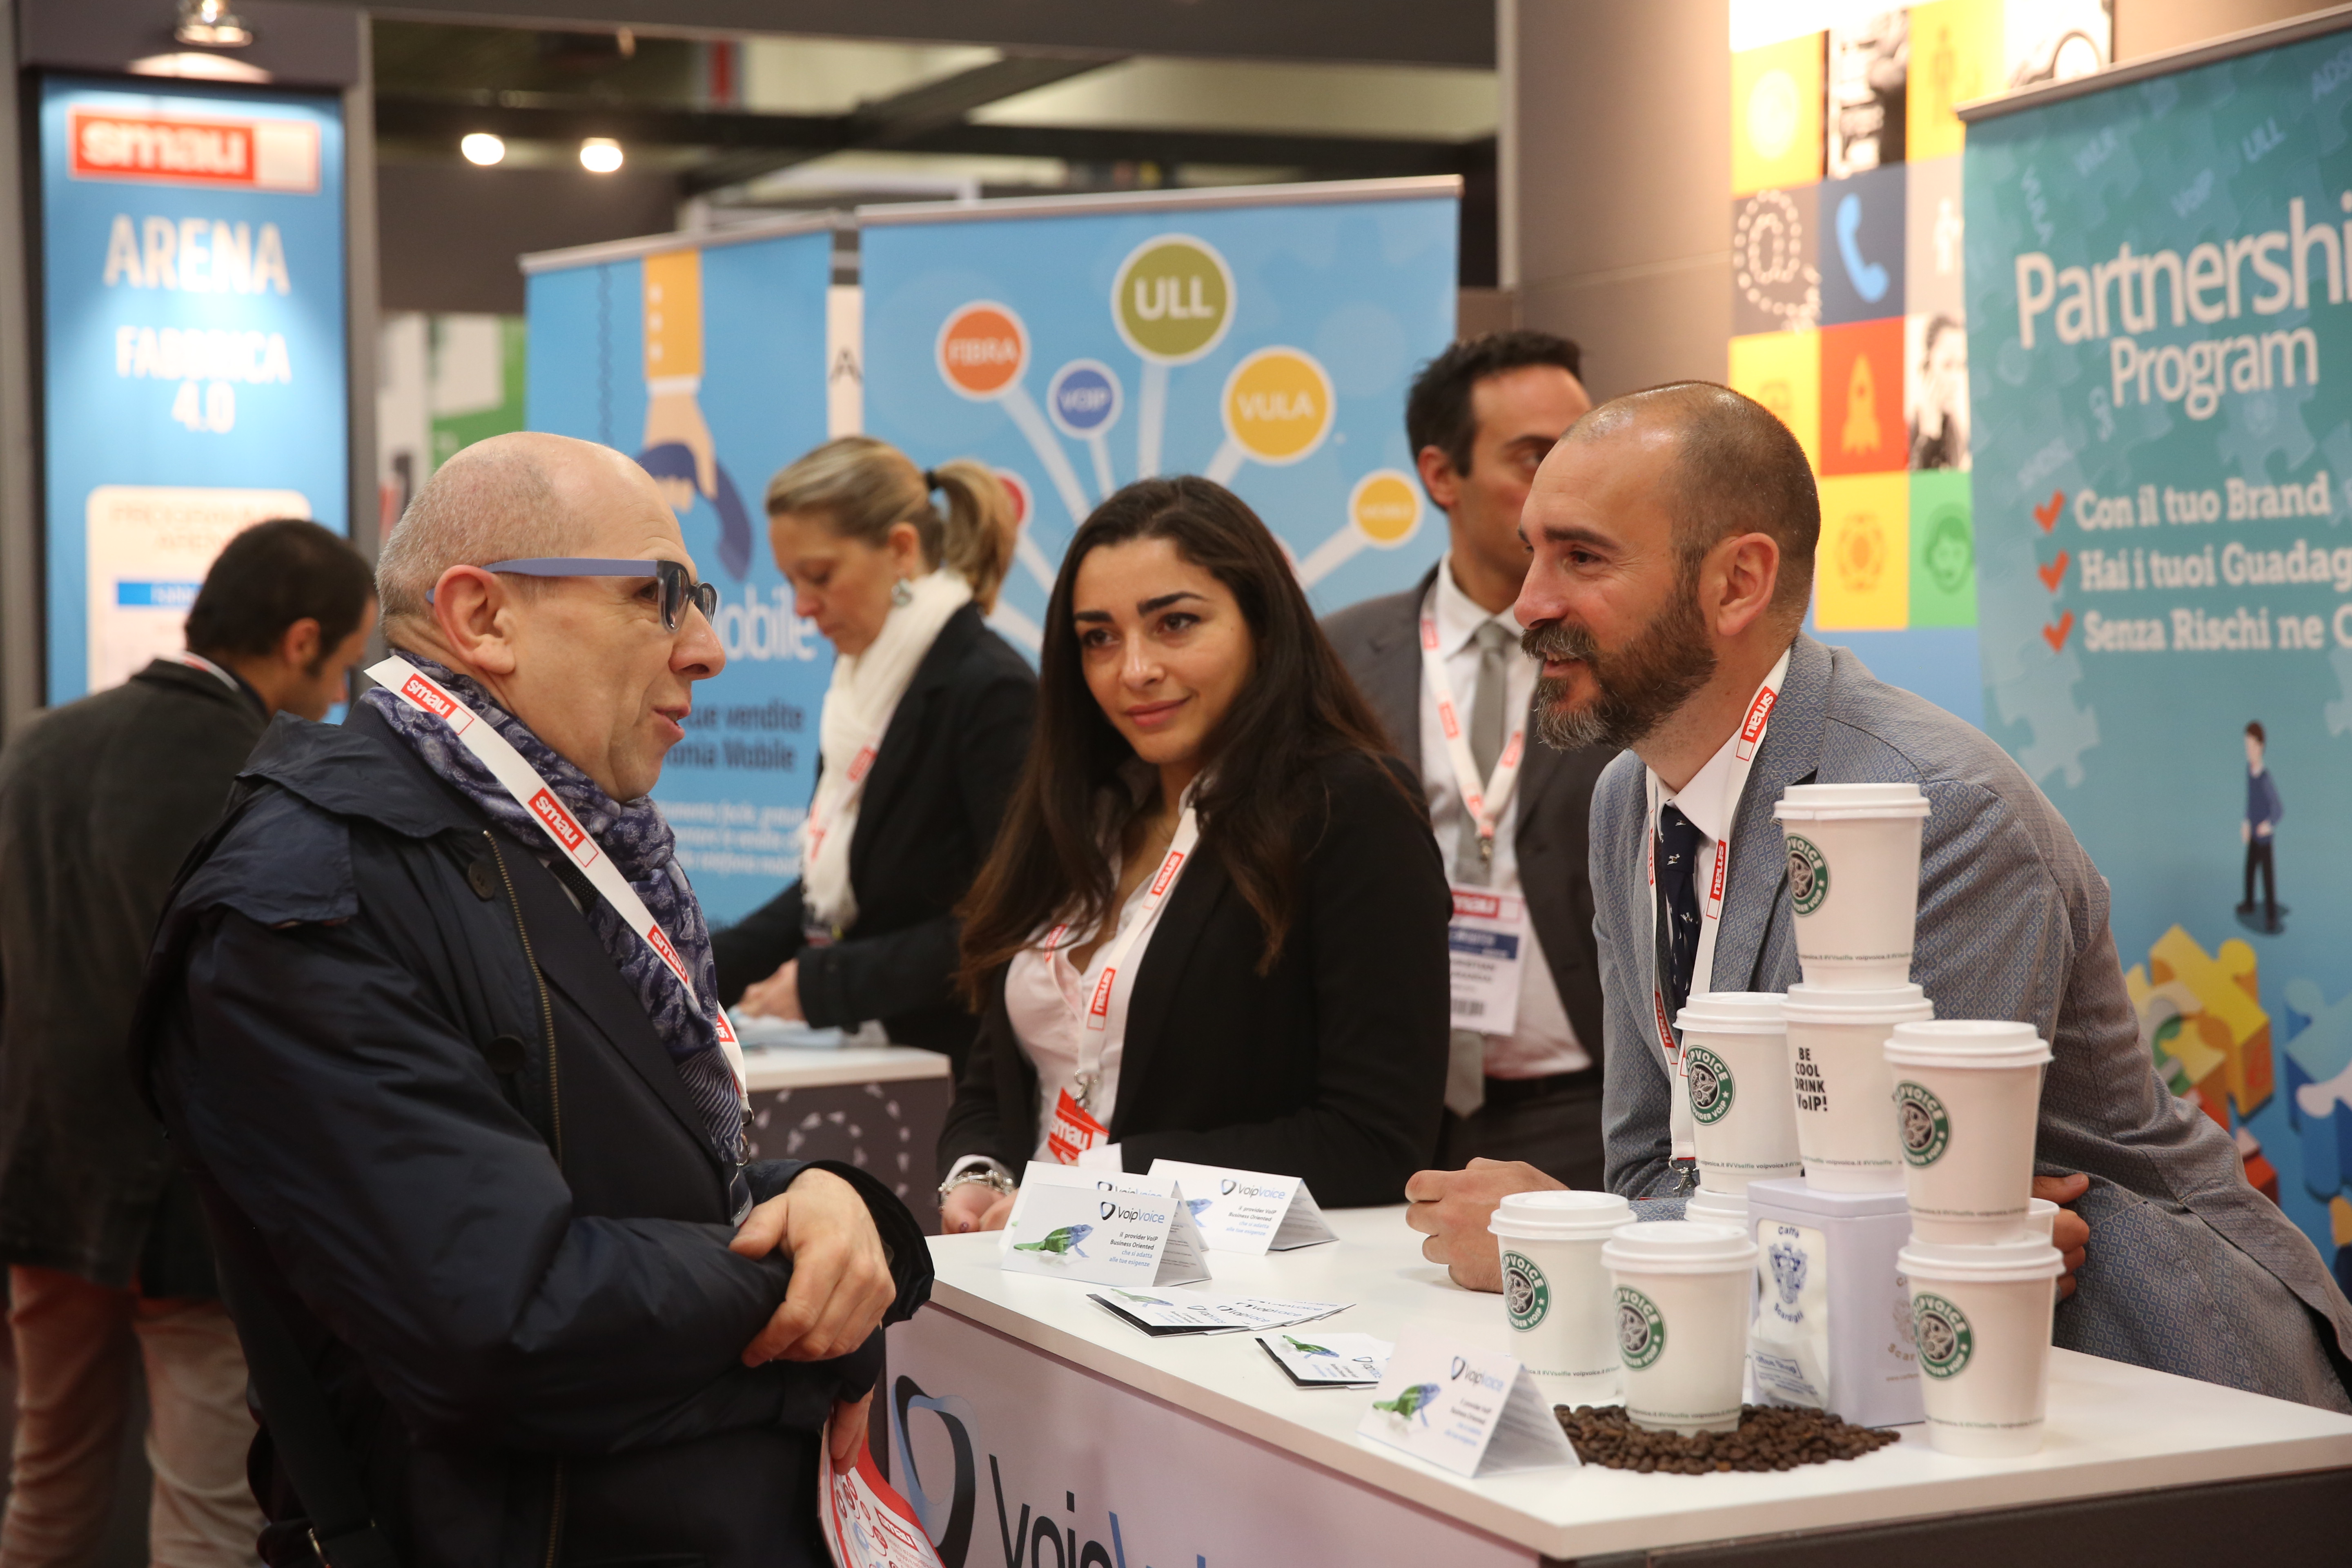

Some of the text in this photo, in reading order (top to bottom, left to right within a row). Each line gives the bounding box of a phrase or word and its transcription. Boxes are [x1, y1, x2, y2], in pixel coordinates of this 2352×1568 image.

[81, 121, 243, 174] smau
[103, 213, 291, 296] ARENA
[2016, 190, 2352, 350] Partnershi
[1136, 275, 1214, 320] ULL
[948, 337, 1017, 367] FIBRA
[2110, 326, 2319, 421] Program
[171, 380, 235, 433] 4.0
[1058, 386, 1111, 411] VOIP
[1236, 393, 1314, 422] VULA
[2075, 471, 2332, 530] Con il tuo Brand
[2078, 539, 2352, 592] Hai i tuoi Guadag
[2083, 610, 2166, 652] Senza
[2171, 607, 2271, 650] Rischi
[2278, 614, 2325, 649] ne
[407, 679, 451, 716] smau
[1744, 692, 1774, 738] smau
[535, 796, 579, 844] smau
[1713, 844, 1725, 896] smau
[1786, 838, 1823, 869] PVOICE
[1155, 855, 1178, 892] smau
[652, 931, 688, 979] smau
[1093, 971, 1113, 1011] smau
[1686, 1050, 1728, 1081] OIPVOICE
[1795, 1062, 1820, 1077] COOL
[1798, 1047, 1810, 1061] BE
[1795, 1077, 1825, 1093] DRINK
[1796, 1093, 1827, 1111] VoIP!
[1712, 1100, 1726, 1117] VOIP
[1899, 1086, 1944, 1120] PVOICE
[1238, 1183, 1285, 1199] VoipVoice
[1118, 1206, 1165, 1224] VoipVoice
[1110, 1239, 1131, 1247] Business
[1124, 1233, 1146, 1241] provider
[1128, 1259, 1150, 1267] esigenze
[1502, 1255, 1544, 1288] IPVOICE
[1528, 1307, 1542, 1324] VOIP
[1913, 1297, 1967, 1332] OIPVOICE
[878, 1513, 914, 1547] smau
